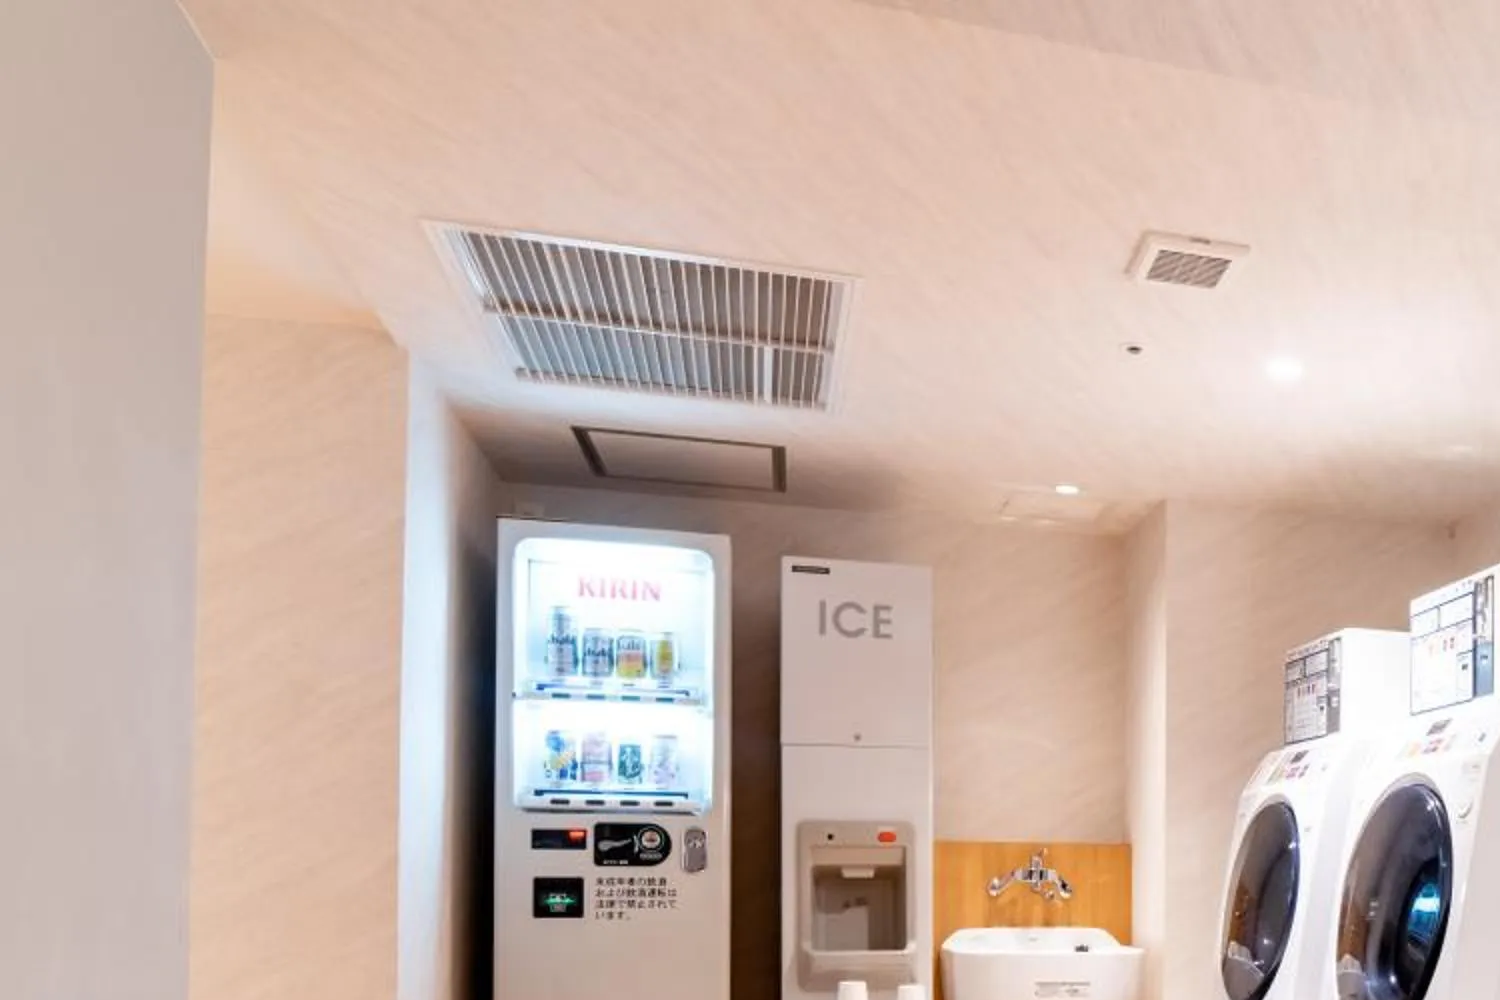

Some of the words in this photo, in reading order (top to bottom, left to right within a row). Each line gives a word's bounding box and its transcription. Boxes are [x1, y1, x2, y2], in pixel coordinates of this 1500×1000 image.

[578, 576, 662, 602] KIRIN
[818, 600, 894, 639] ICE
[595, 888, 678, 898] および飲酒運転は
